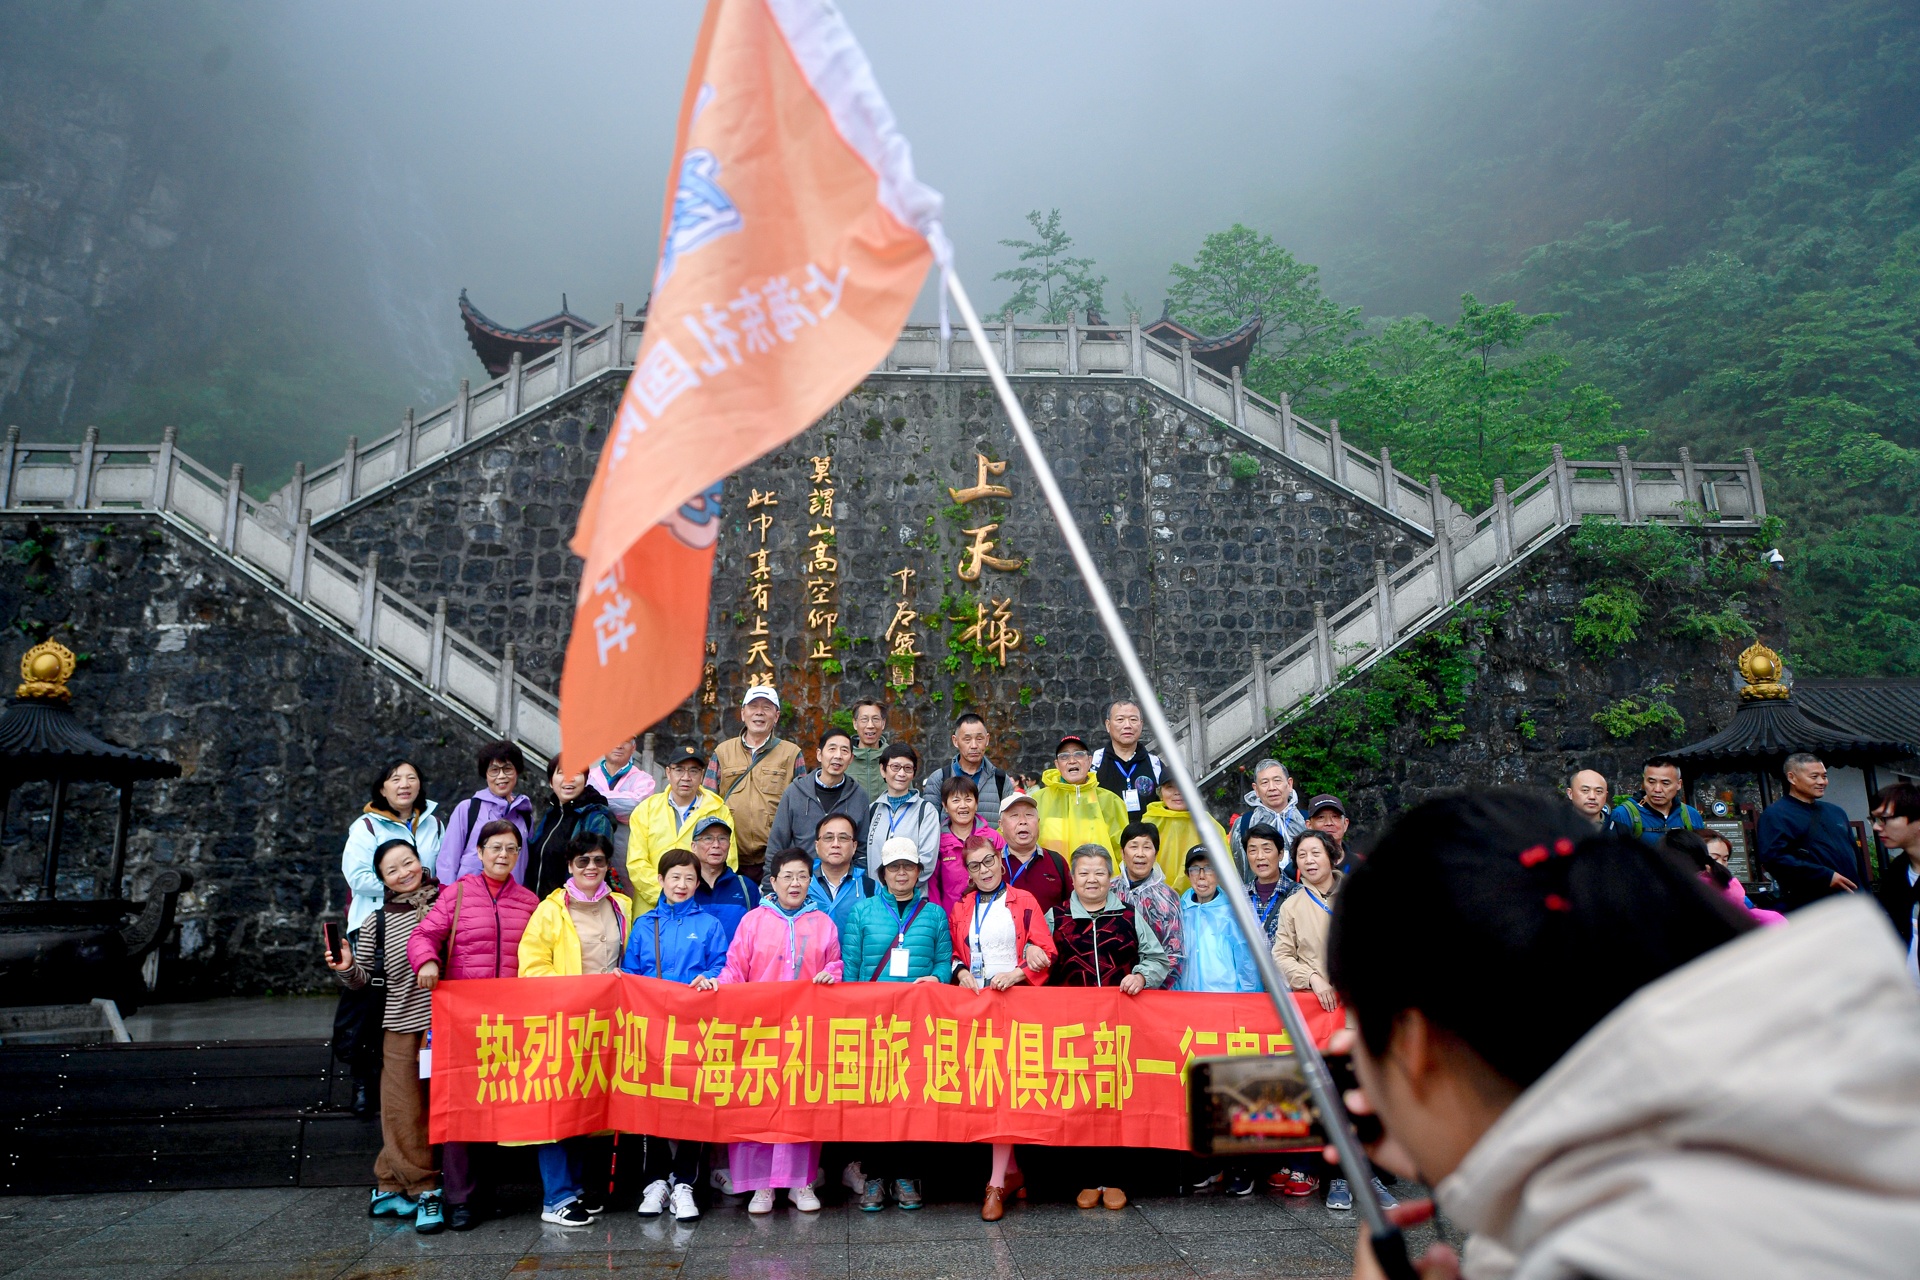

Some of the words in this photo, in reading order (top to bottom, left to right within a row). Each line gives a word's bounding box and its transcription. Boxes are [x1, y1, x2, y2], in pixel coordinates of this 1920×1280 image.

[949, 454, 1022, 667] 上天梯
[475, 1007, 911, 1106] 热烈欢迎上海东礼国旅
[923, 1014, 1294, 1114] 退休俱乐部一
